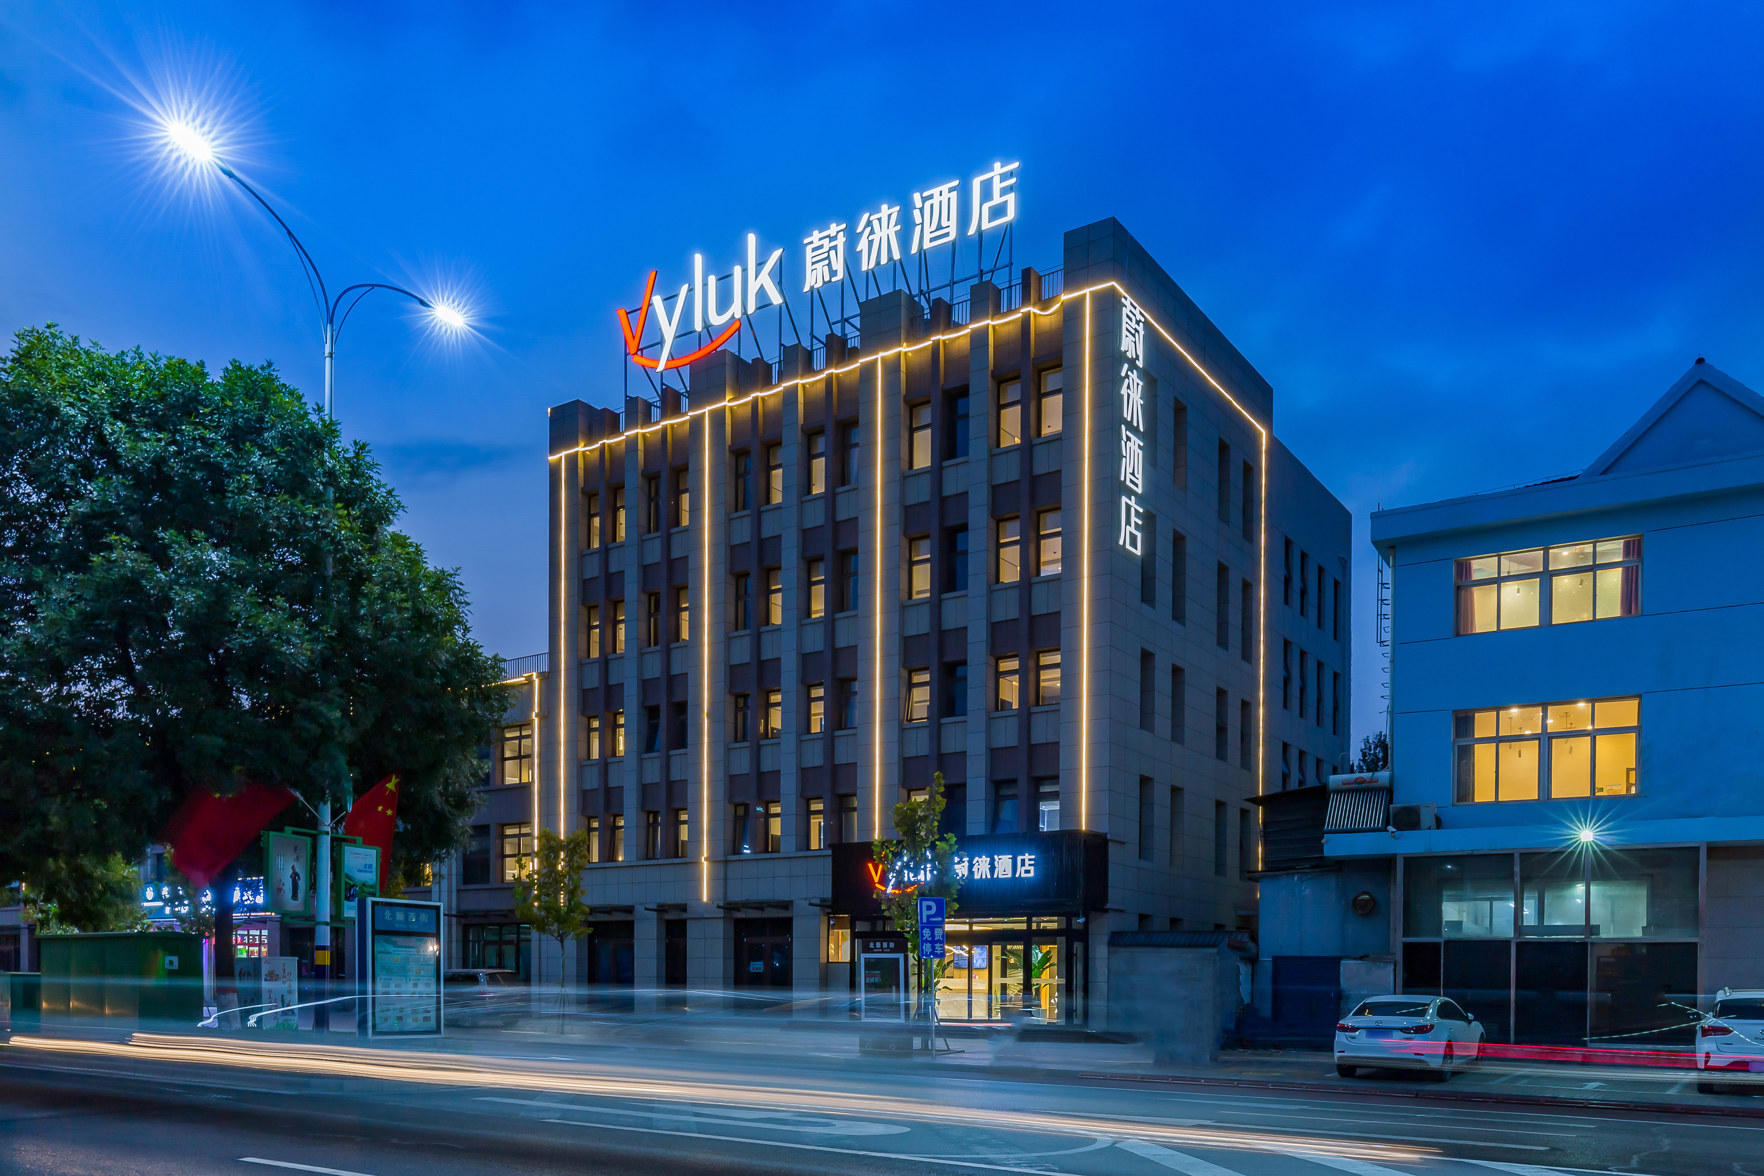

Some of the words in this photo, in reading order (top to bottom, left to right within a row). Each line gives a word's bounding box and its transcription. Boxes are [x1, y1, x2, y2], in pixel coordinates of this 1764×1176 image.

[803, 161, 1020, 293] 蔚徕酒店
[1119, 297, 1145, 556] 蔚徕酒店
[922, 901, 936, 923] P
[922, 927, 943, 940] 免费
[922, 942, 944, 955] 停车
